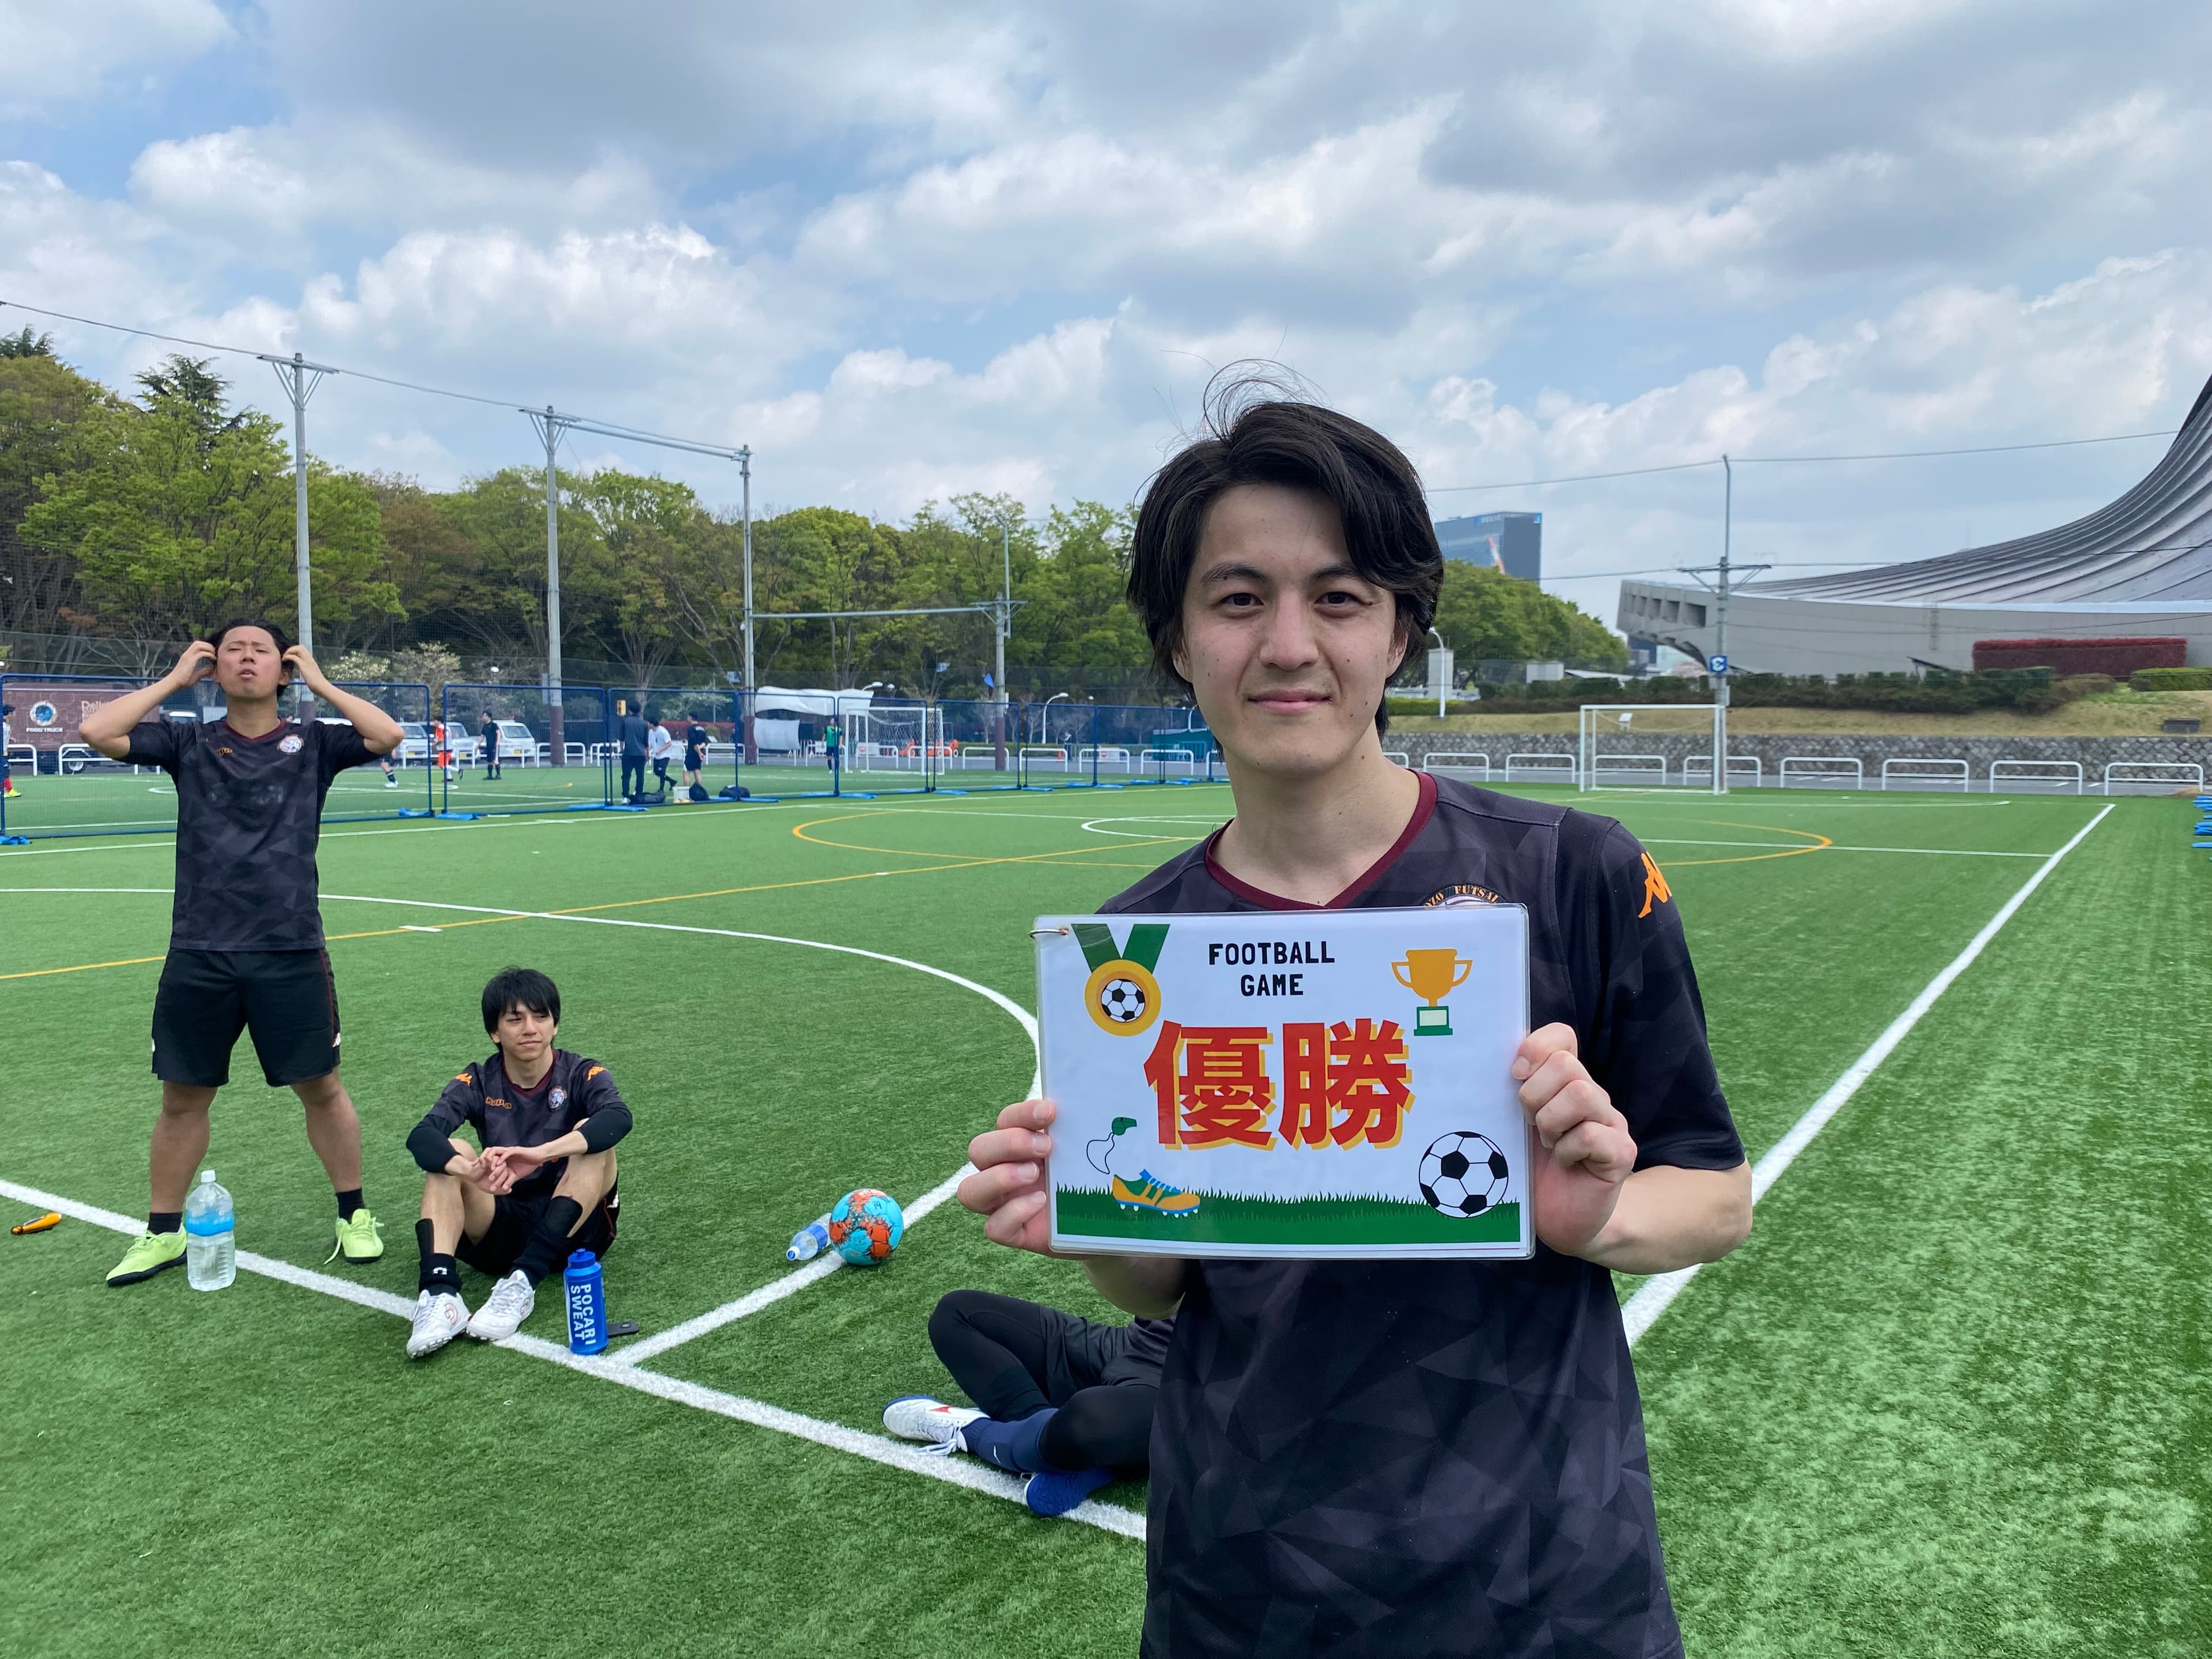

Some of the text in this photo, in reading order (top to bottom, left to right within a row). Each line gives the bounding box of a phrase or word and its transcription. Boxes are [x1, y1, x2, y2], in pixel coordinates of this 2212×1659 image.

[1209, 941, 1335, 965] FOOTBALL
[1240, 974, 1304, 997] GAME
[1143, 1017, 1416, 1152] 優勝
[570, 1285, 585, 1340] SWEAT
[580, 1283, 597, 1345] POCARI
